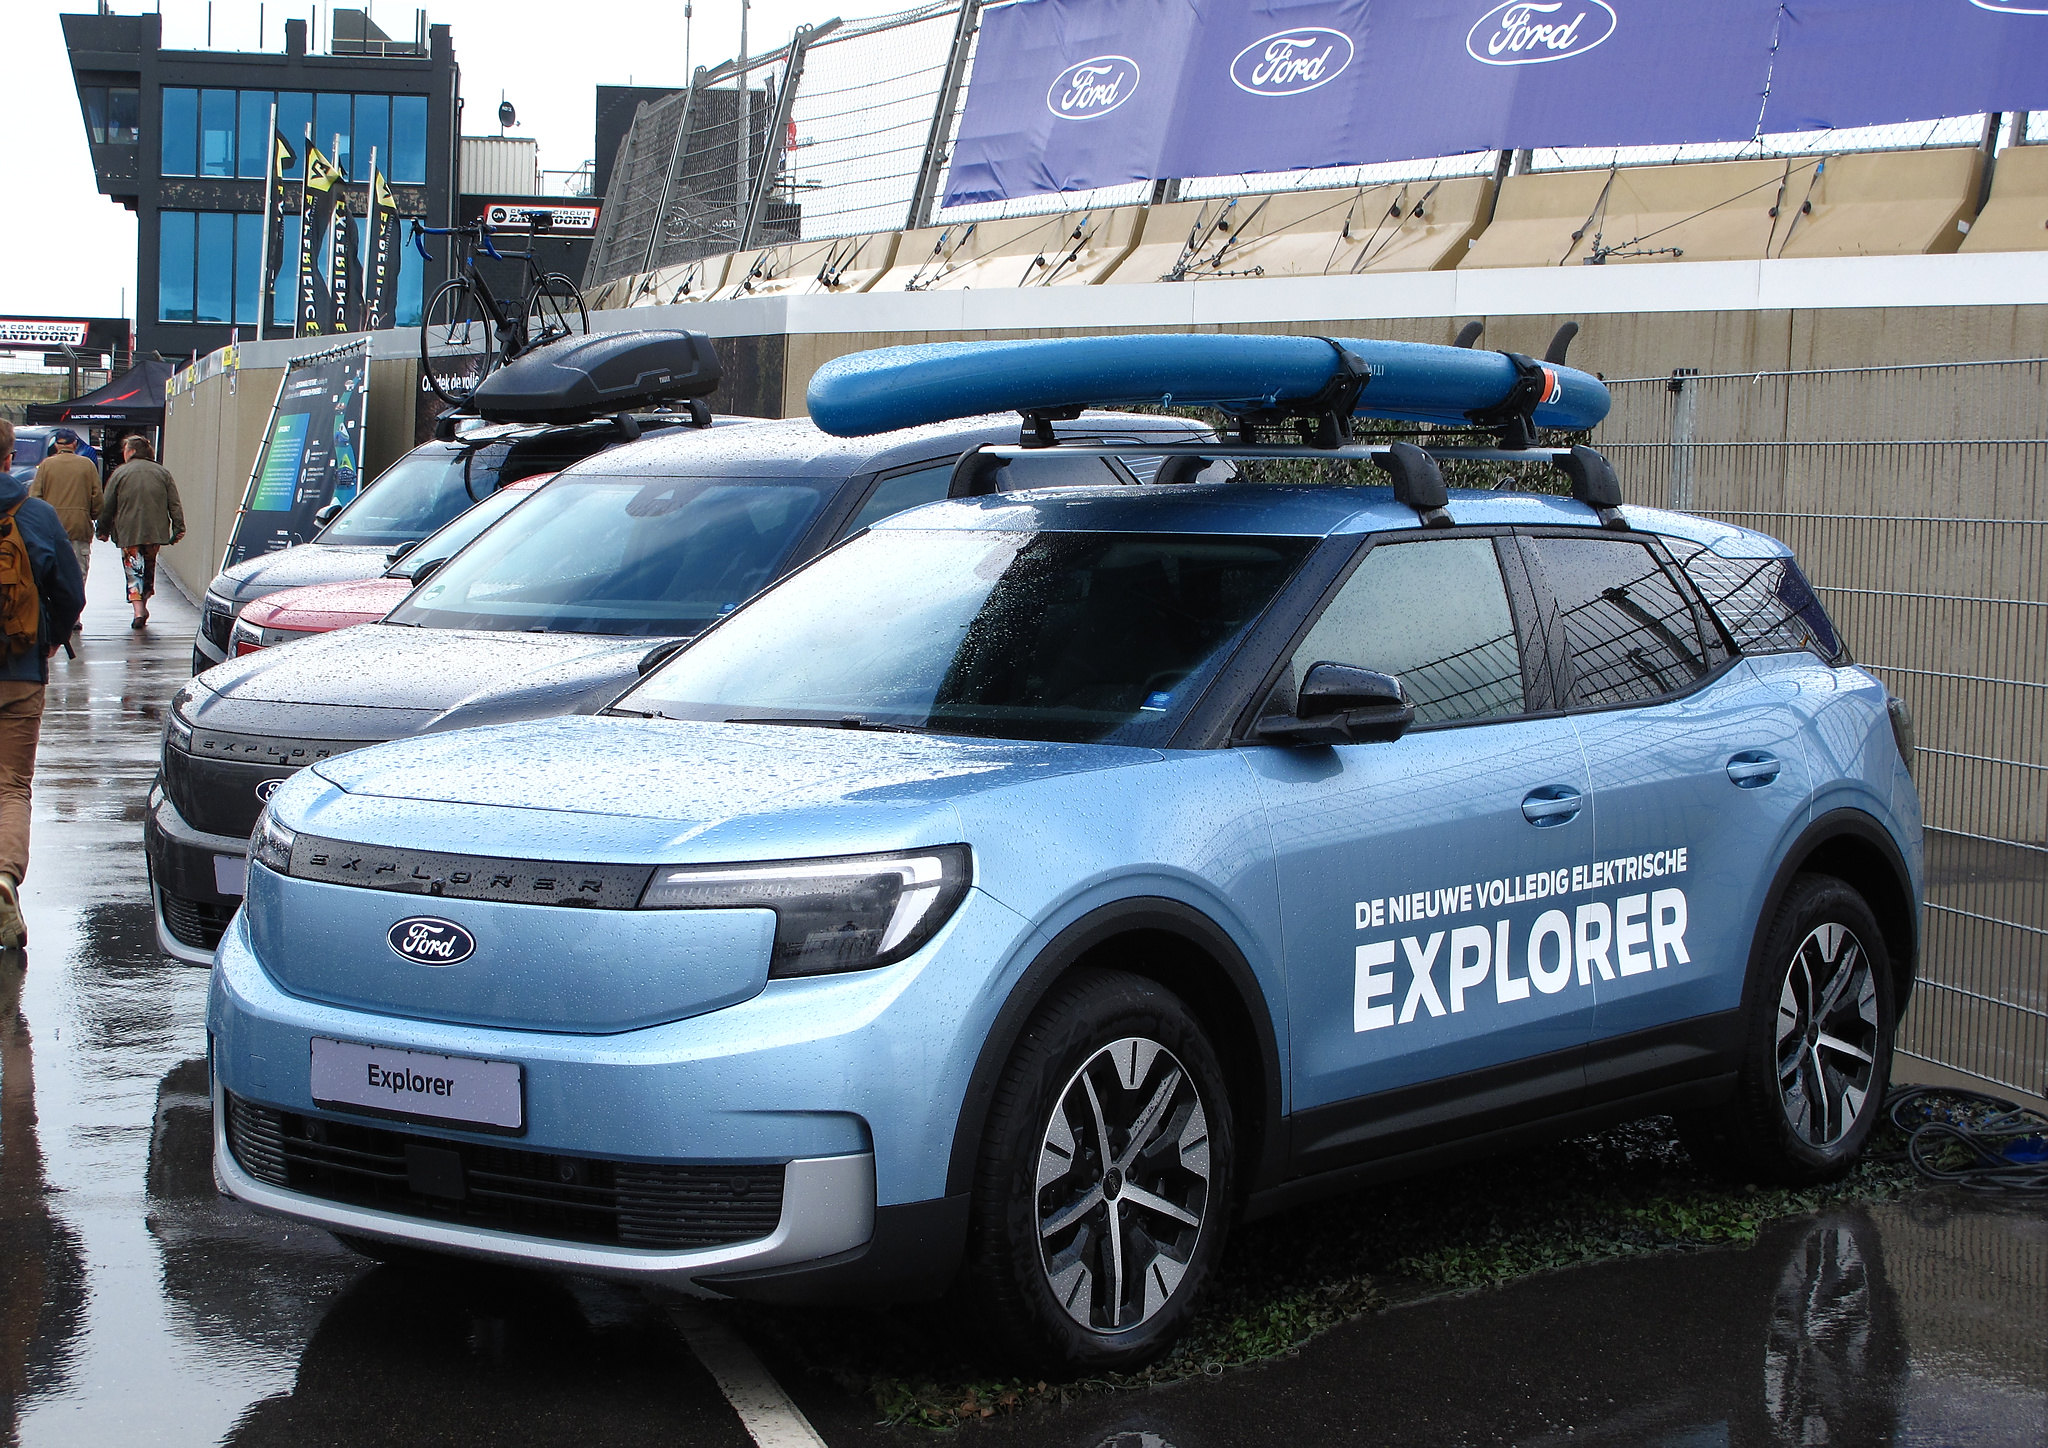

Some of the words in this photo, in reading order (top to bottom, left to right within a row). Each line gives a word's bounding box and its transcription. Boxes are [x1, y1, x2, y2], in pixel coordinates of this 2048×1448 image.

[1487, 2, 1587, 56] Ford
[1251, 38, 1333, 86] Ford
[1061, 64, 1125, 111] Ford
[0, 330, 79, 342] ANDVOORT
[202, 740, 331, 758] EXPLOR
[309, 853, 603, 893] EXPLORER
[1355, 898, 1385, 930] DE
[1388, 885, 1472, 924] NIEUWE
[1475, 868, 1569, 909] VOLLEDIG
[1572, 847, 1688, 892] ELEKTRISCHE
[402, 923, 458, 958] Ford
[1353, 887, 1691, 1033] EXPLORER
[367, 1063, 454, 1097] Explorer
